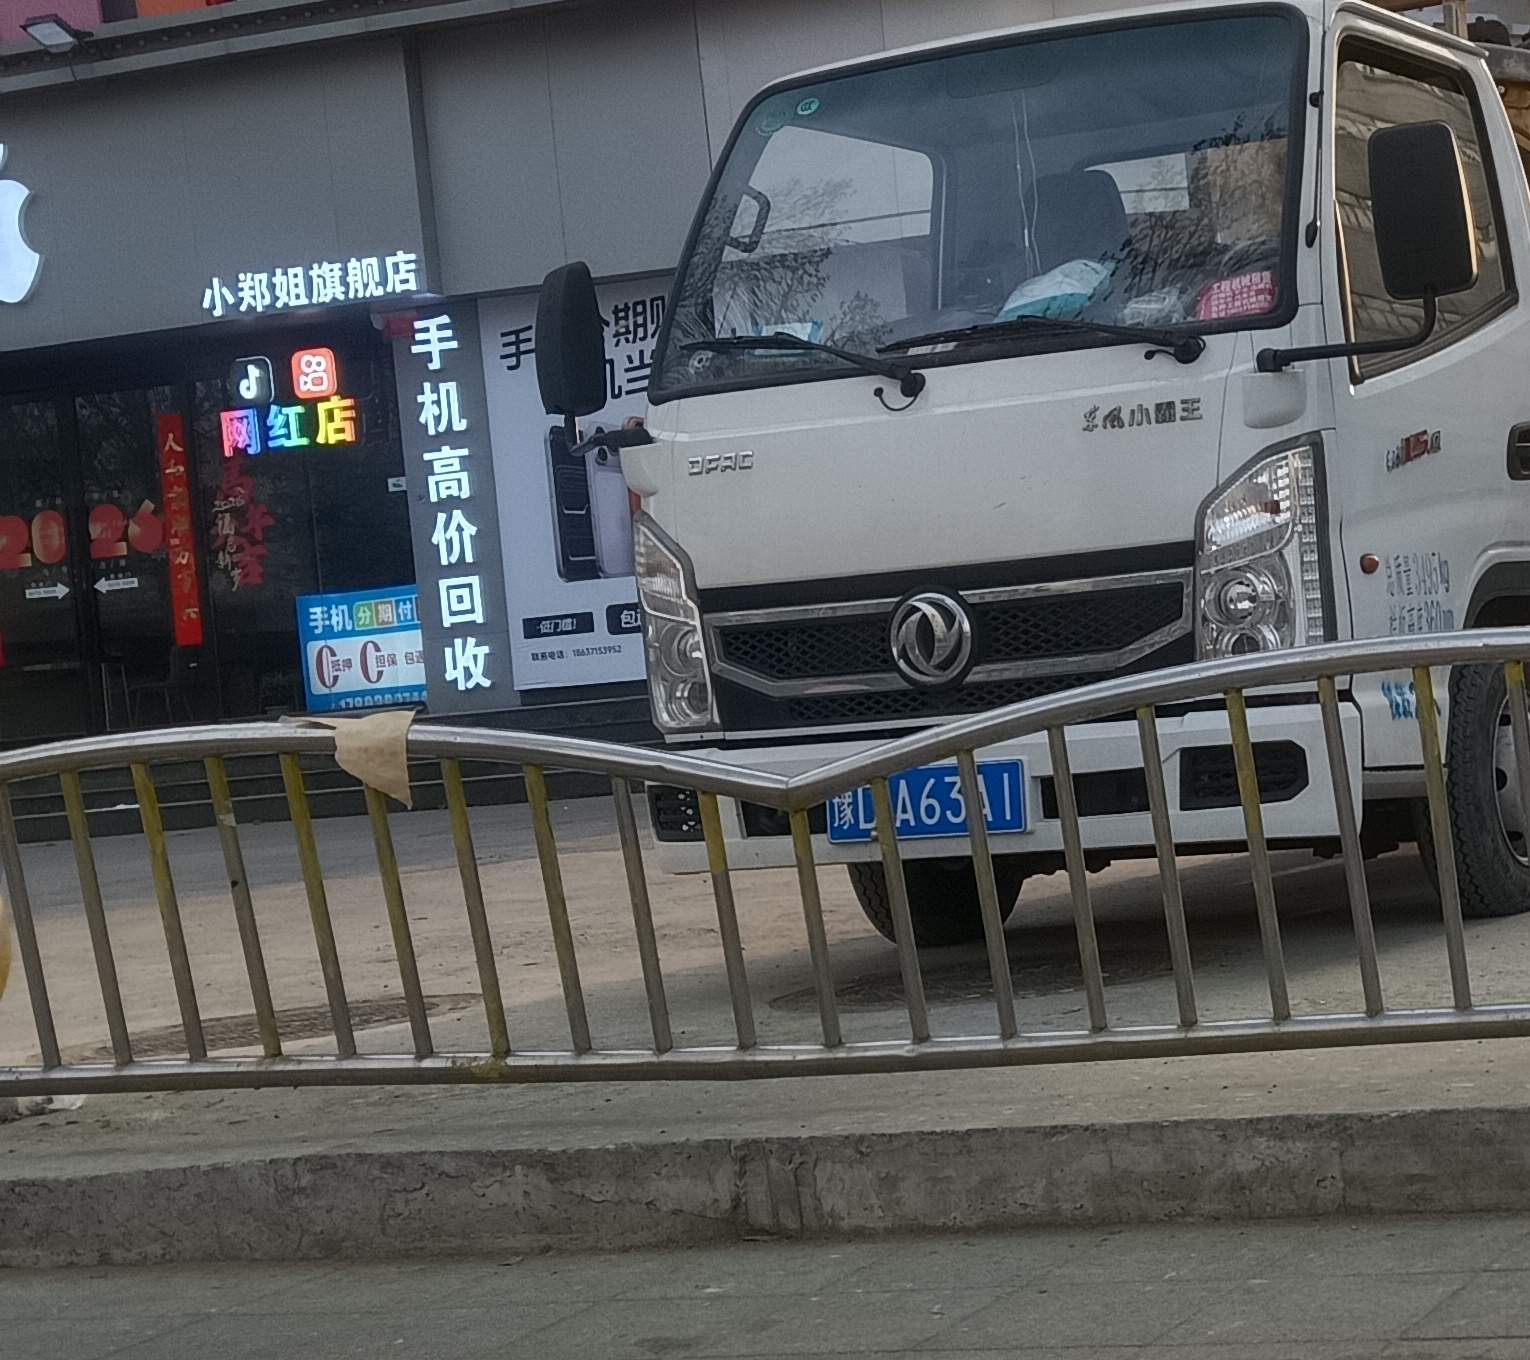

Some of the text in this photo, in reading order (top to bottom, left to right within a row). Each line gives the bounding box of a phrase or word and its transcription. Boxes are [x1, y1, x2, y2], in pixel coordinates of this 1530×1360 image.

[202, 250, 417, 317] 小郑姐旗舰店
[219, 394, 357, 458] 网红店
[410, 314, 492, 691] 手机高价回收
